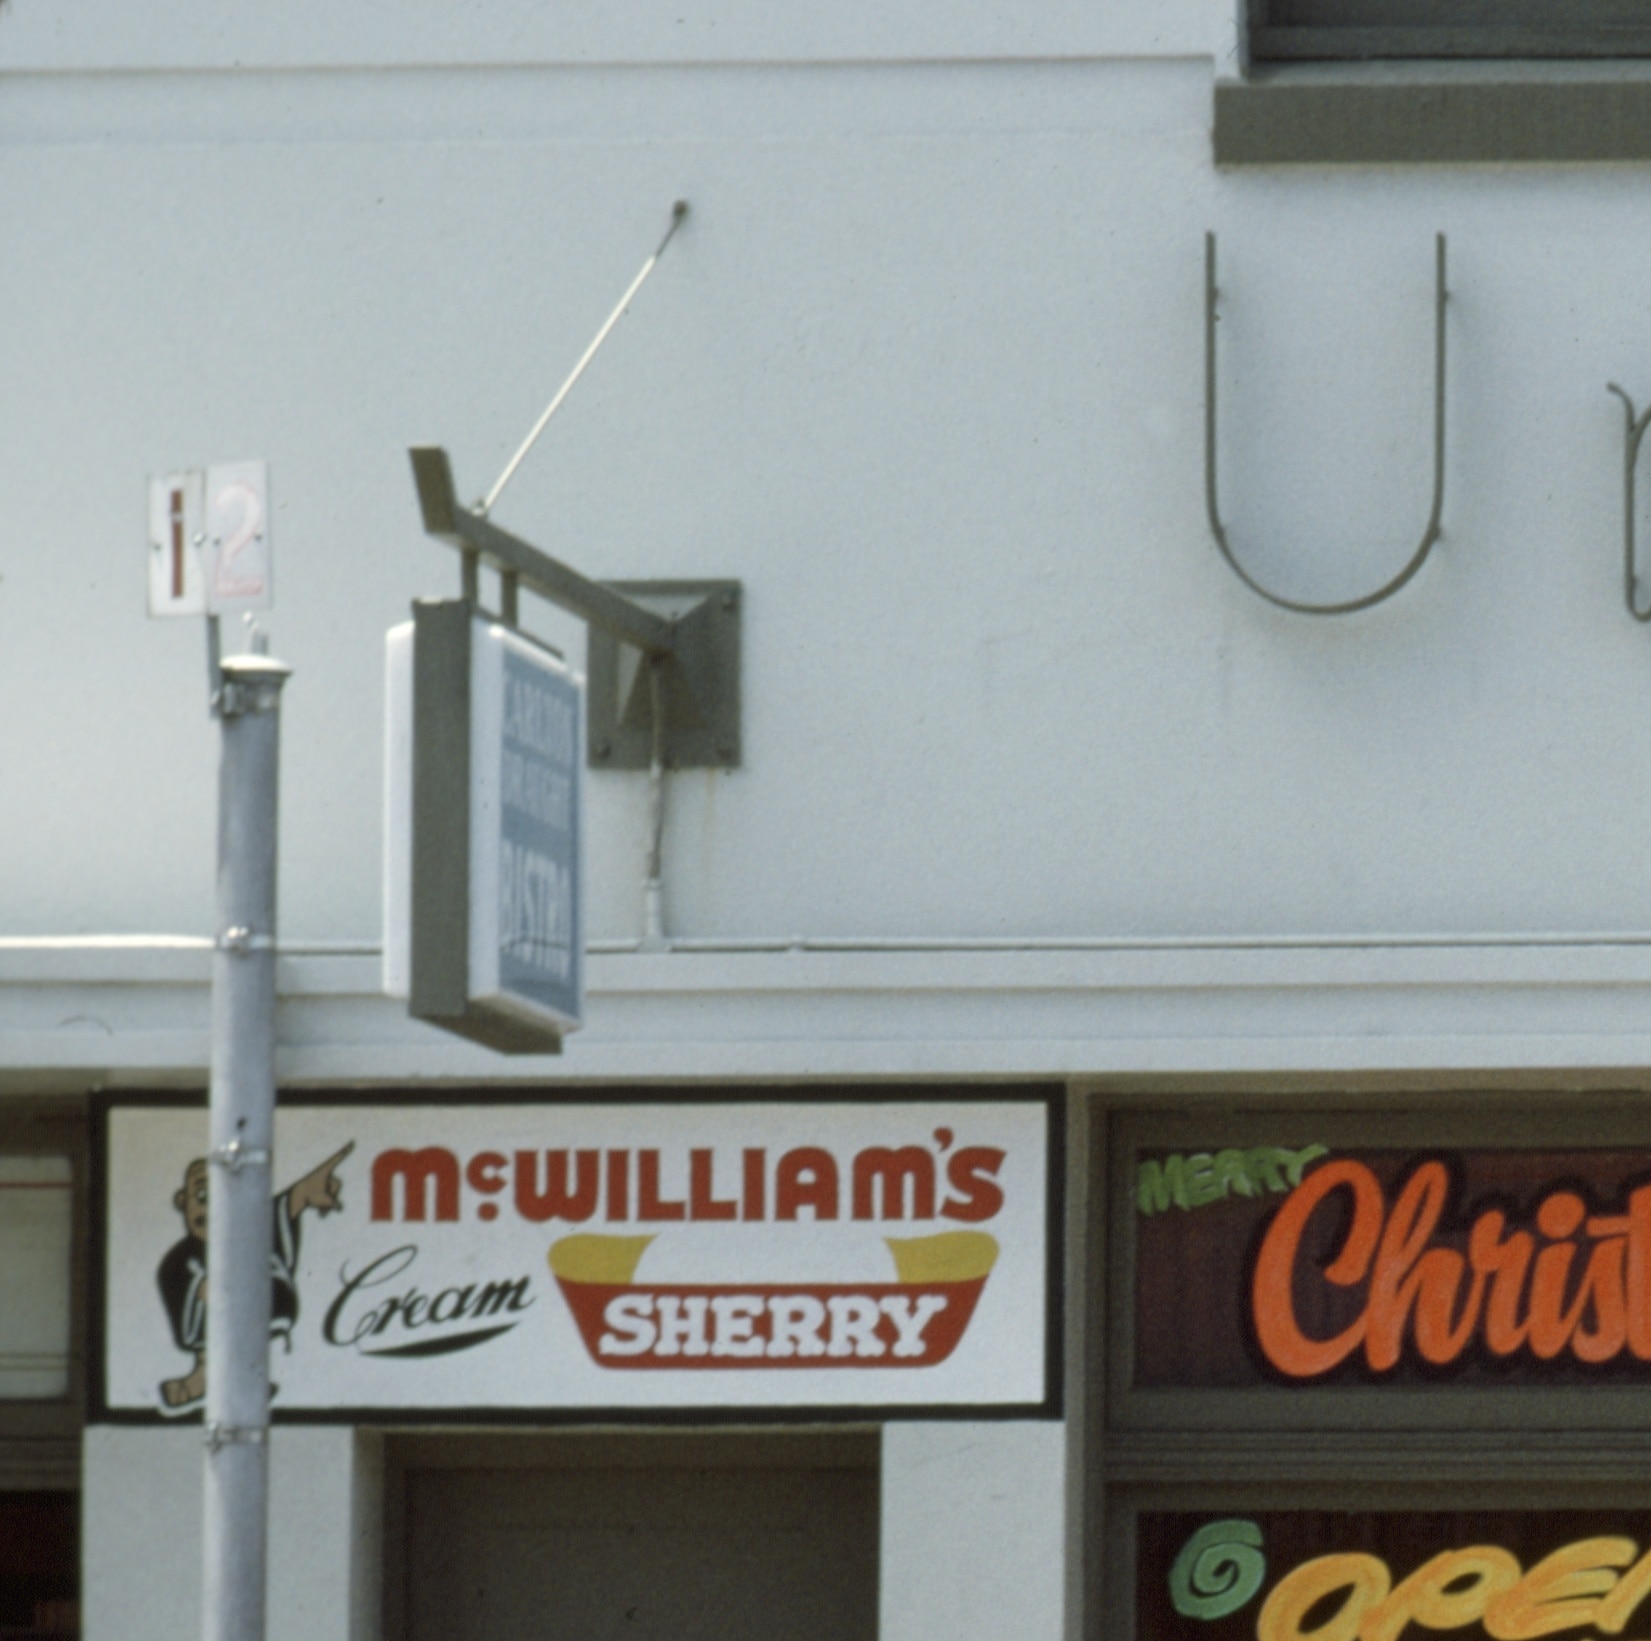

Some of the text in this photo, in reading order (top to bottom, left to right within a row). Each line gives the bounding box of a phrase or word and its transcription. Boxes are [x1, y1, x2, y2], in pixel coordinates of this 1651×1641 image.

[1136, 1144, 1328, 1216] MERRY
[322, 1244, 536, 1350] Cream
[600, 1294, 948, 1358] SHERRY
